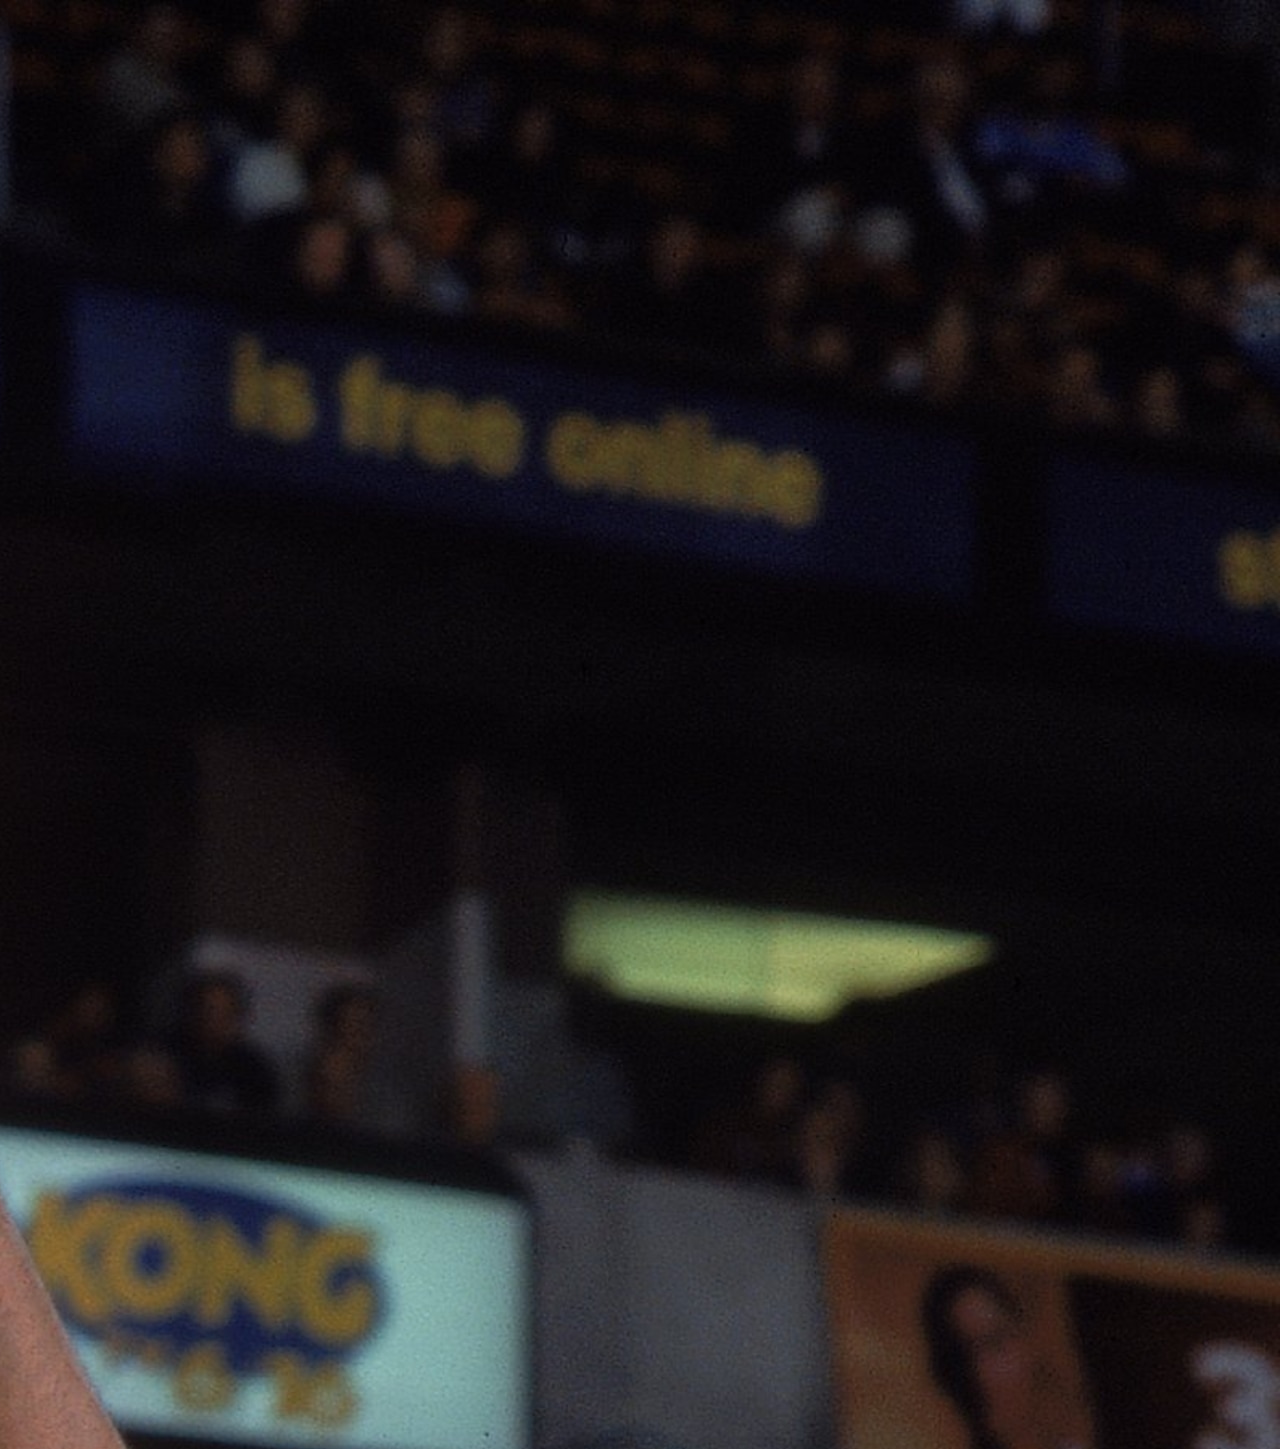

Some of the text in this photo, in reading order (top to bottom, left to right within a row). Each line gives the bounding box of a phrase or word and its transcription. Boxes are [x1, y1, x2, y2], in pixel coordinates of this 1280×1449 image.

[230, 335, 822, 528] is free online
[28, 1184, 380, 1348] KONG
